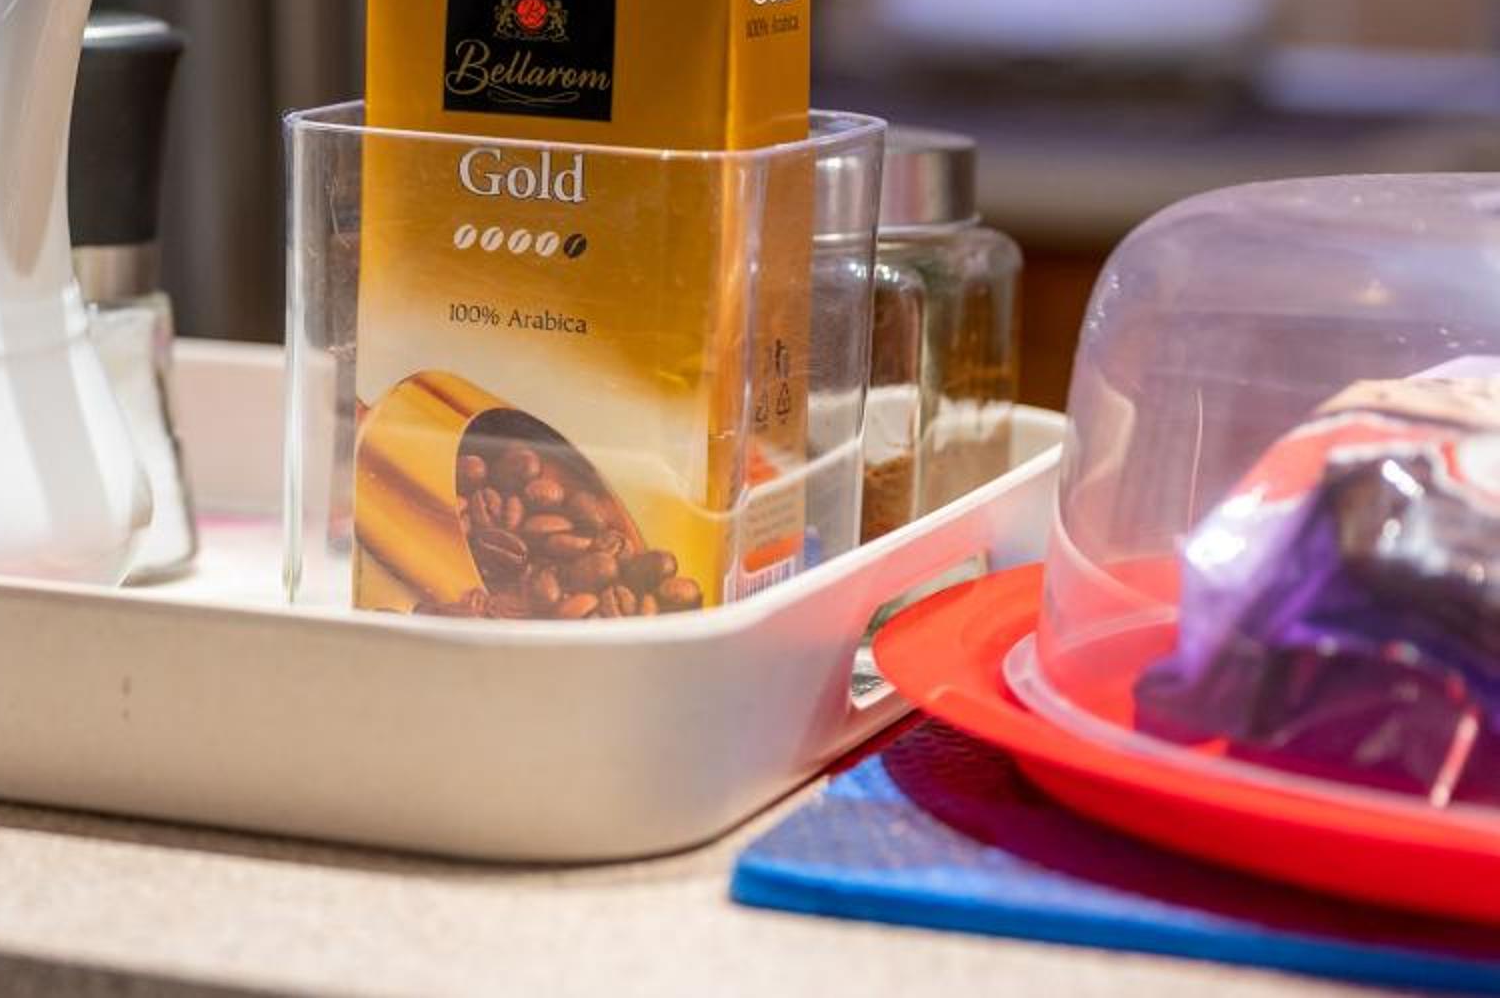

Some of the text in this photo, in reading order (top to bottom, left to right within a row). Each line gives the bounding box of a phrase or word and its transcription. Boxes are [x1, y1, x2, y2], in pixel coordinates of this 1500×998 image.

[445, 38, 611, 100] Bellarom
[458, 145, 587, 203] Gold
[449, 303, 588, 335] 100% Arabica
